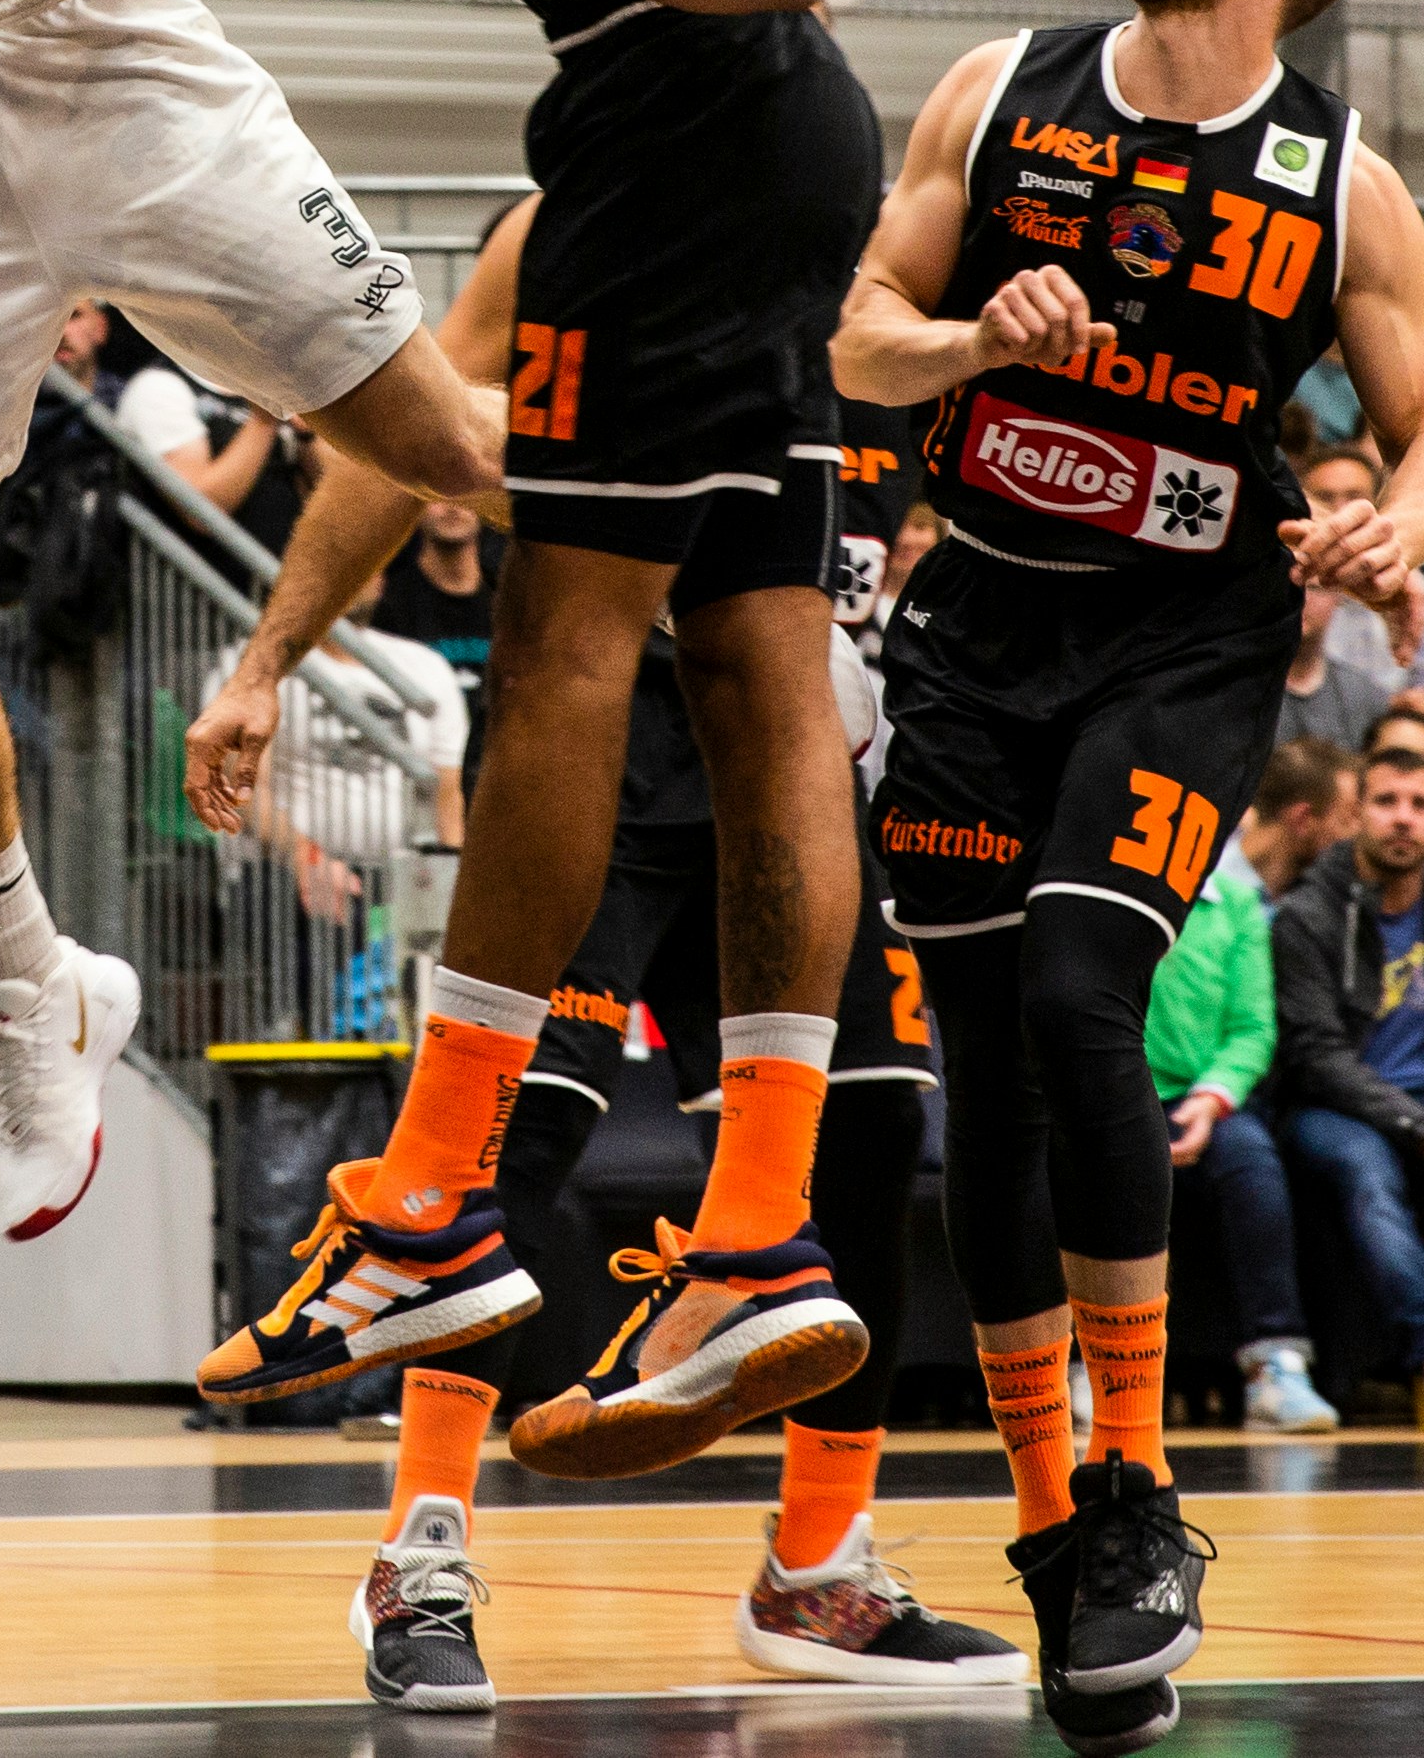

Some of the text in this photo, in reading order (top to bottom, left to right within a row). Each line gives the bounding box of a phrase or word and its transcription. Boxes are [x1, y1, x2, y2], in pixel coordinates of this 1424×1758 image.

[298, 187, 370, 269] 3
[1017, 170, 1094, 199] SPALDING
[1187, 189, 1323, 320] 30
[509, 321, 588, 441] 21
[976, 423, 1138, 503] Helios
[1109, 768, 1220, 903] 30
